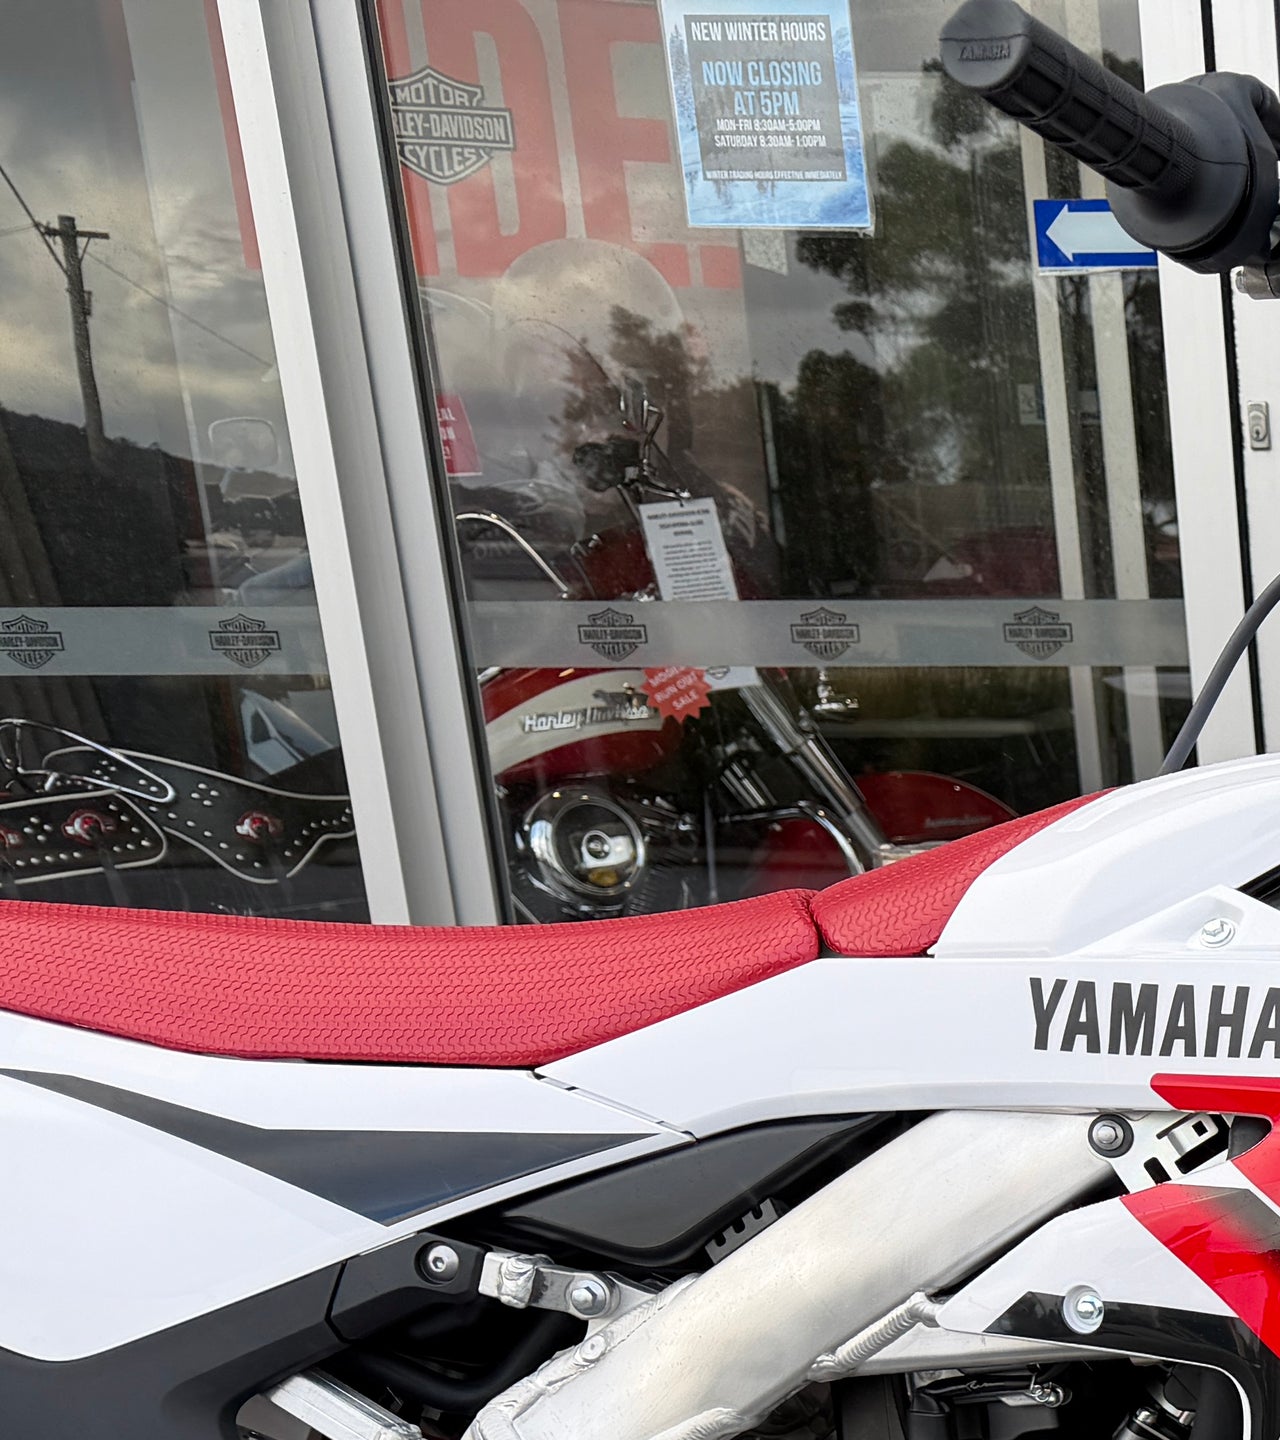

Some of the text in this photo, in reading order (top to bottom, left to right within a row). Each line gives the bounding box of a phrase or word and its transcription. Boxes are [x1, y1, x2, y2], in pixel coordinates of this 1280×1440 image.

[691, 22, 826, 41] NEW WINTER HOURS
[702, 61, 822, 87] NOW CLOSING
[395, 77, 469, 107] MOTOR
[734, 91, 800, 116] AT 5PM
[394, 111, 507, 141] LEY-DAVIDSON
[717, 119, 753, 132] MON-FRI
[714, 135, 758, 148] SATURDAY
[403, 145, 477, 177] CYCLES
